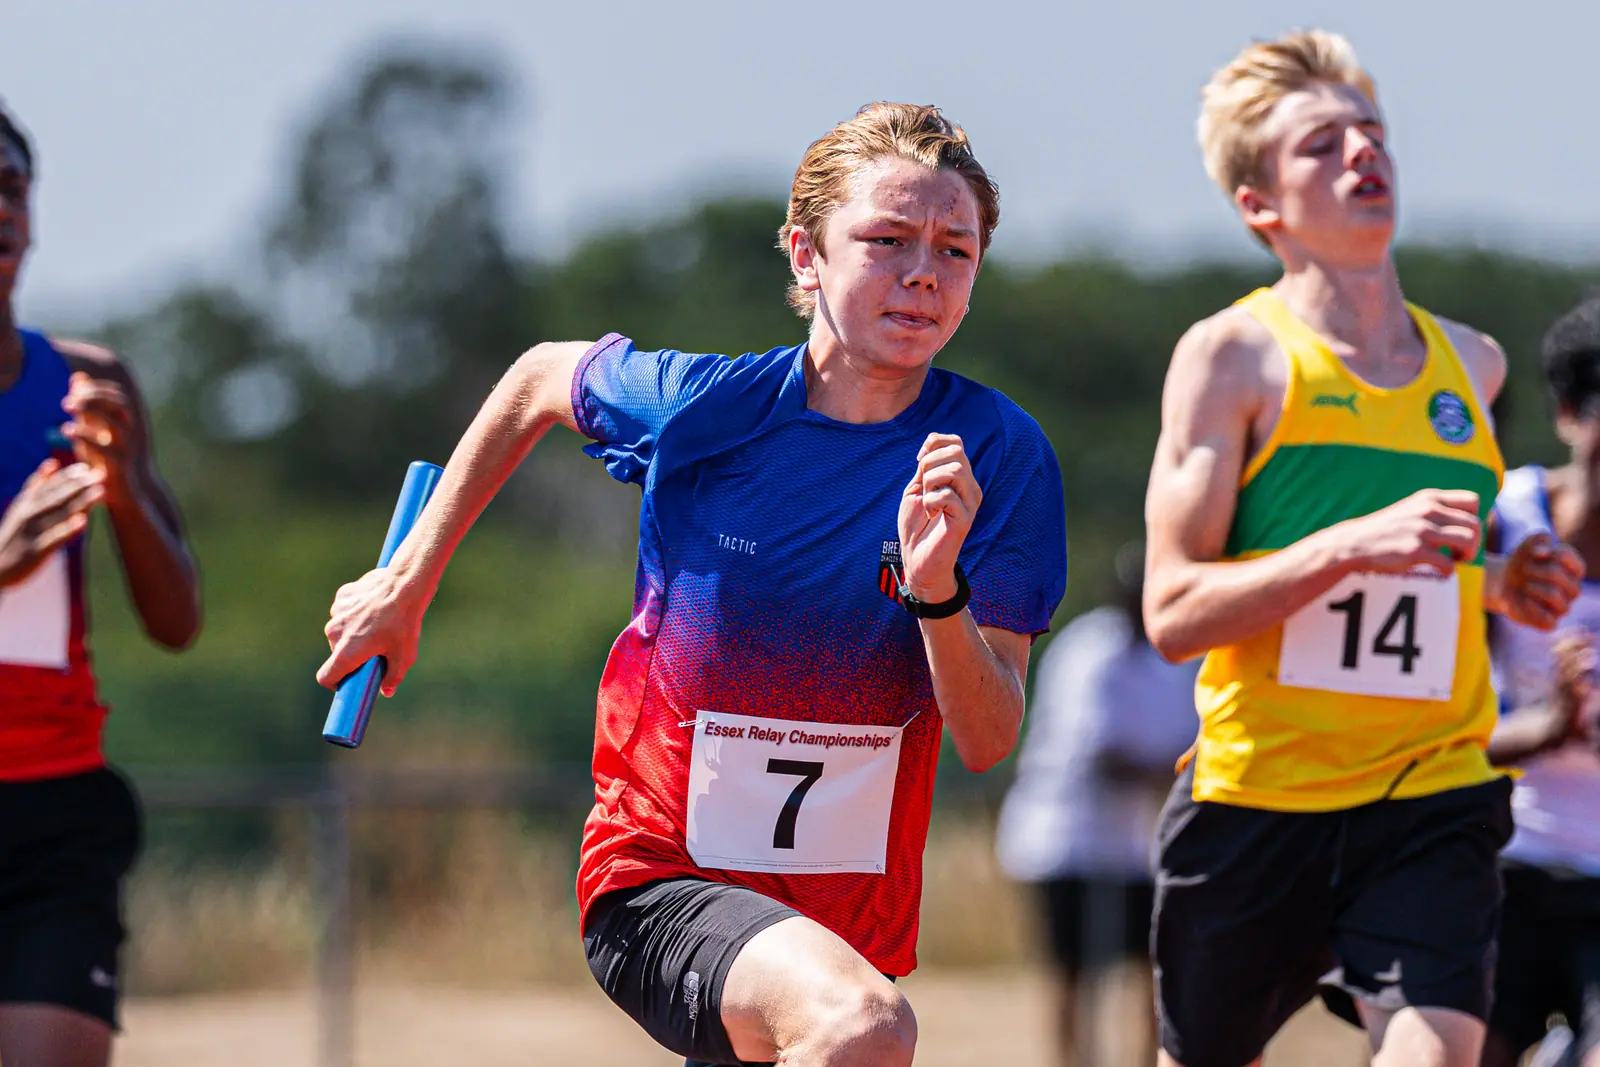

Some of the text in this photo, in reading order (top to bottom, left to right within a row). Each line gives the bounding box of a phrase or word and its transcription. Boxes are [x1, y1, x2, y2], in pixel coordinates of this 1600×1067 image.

[718, 533, 757, 555] TACTIC
[1327, 590, 1422, 674] 14
[704, 721, 891, 749] Essex Relay Championships
[766, 758, 825, 850] 7
